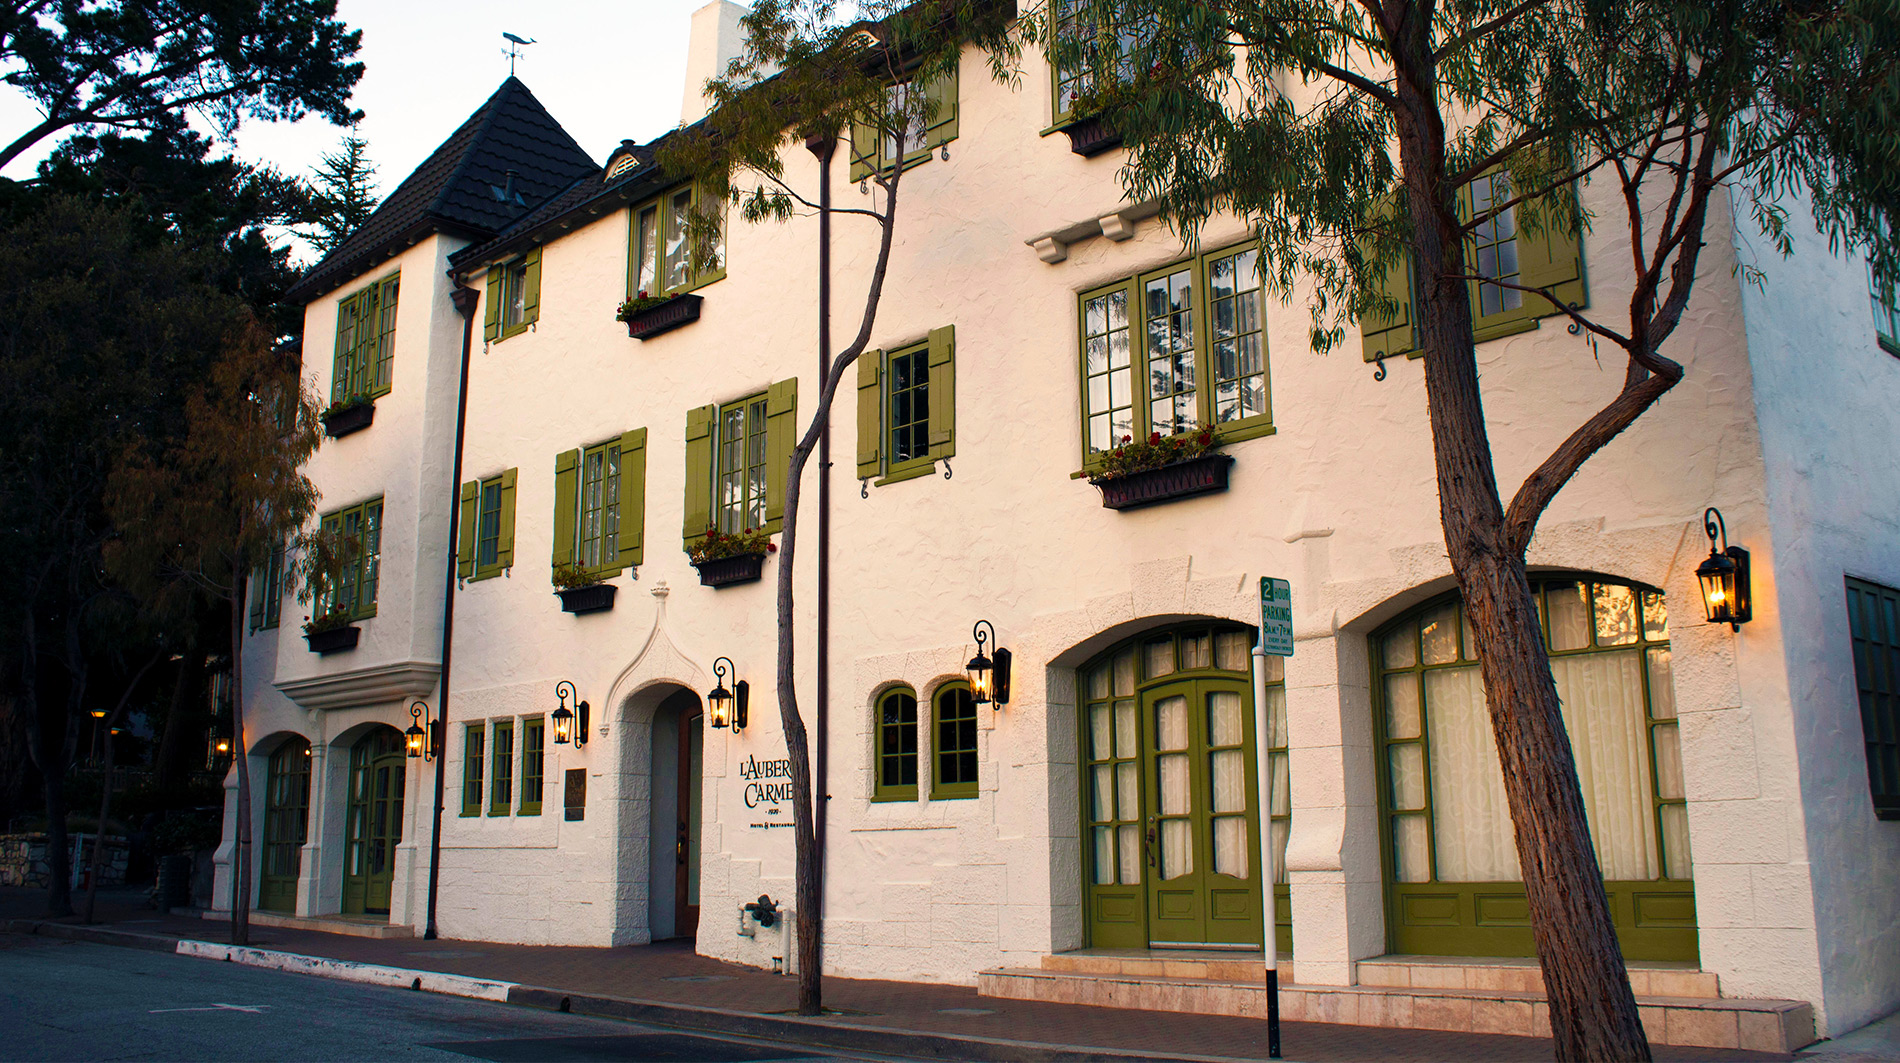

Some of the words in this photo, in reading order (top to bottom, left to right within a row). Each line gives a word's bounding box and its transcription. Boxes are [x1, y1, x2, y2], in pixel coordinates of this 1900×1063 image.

[1263, 581, 1271, 598] 2
[1275, 587, 1289, 600] HOUR
[1263, 604, 1290, 622] PARKING
